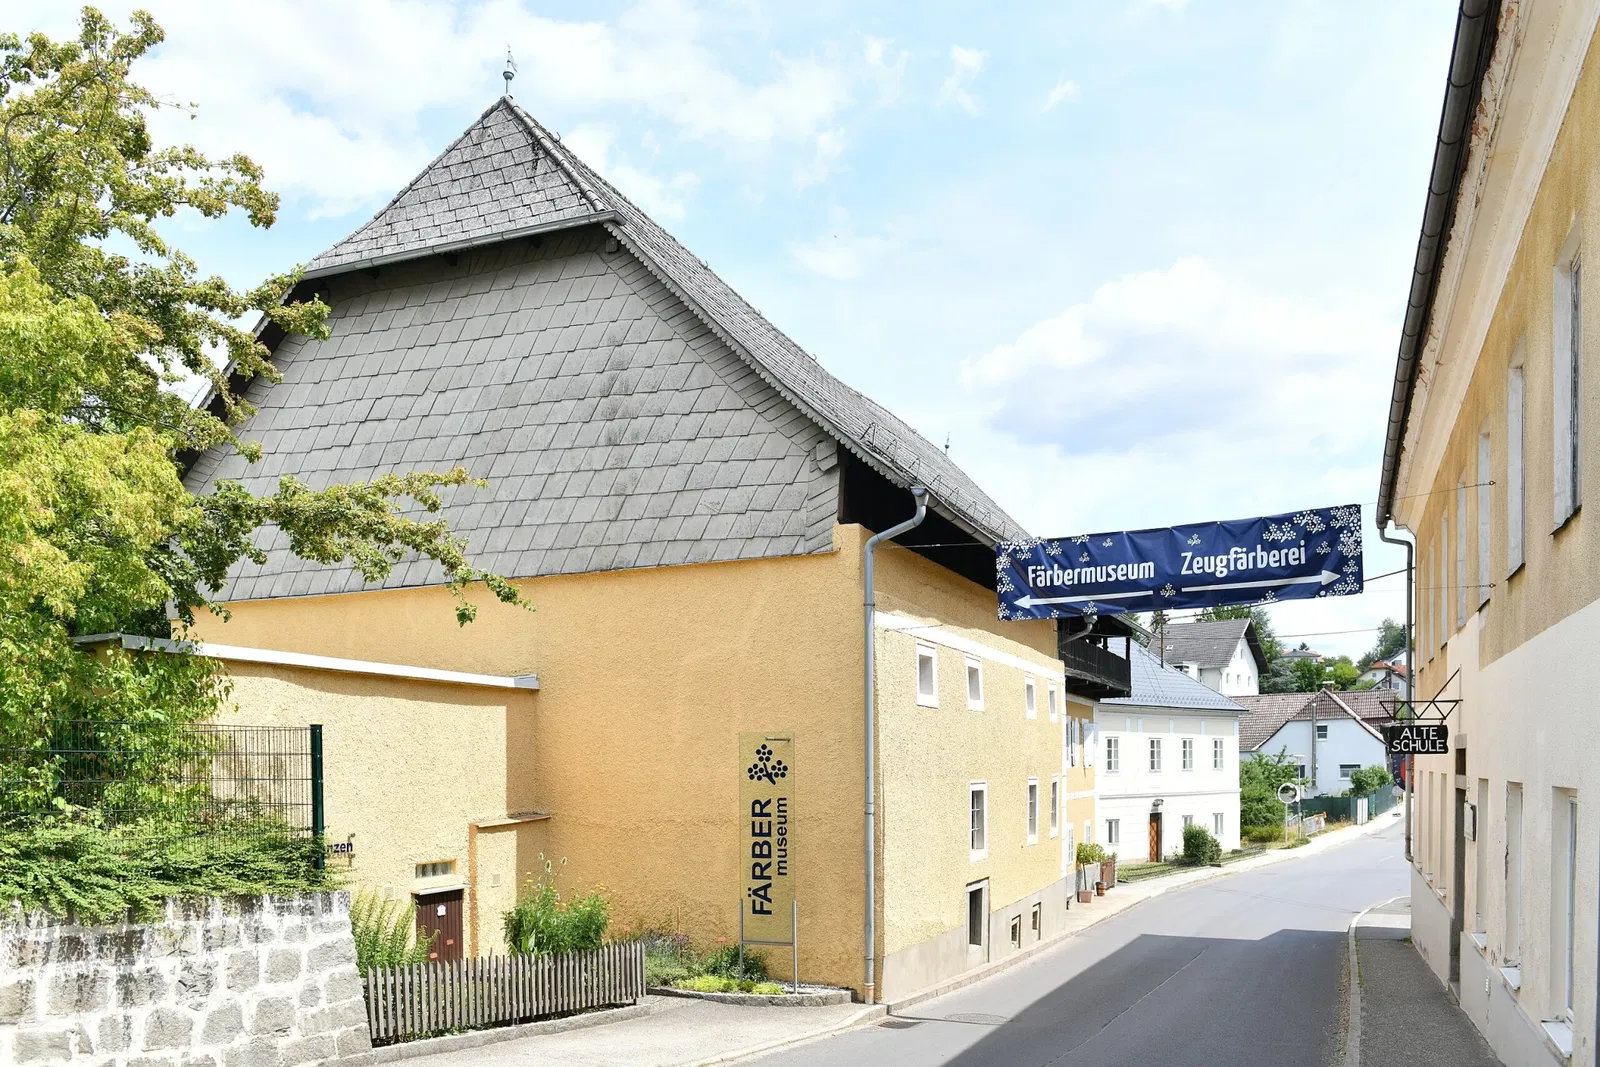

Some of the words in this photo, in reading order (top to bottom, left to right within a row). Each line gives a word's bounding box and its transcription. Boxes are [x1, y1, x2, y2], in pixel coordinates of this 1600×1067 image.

[1027, 559, 1155, 588] Färbermuseum
[1180, 540, 1306, 578] Zeugfärberei
[1391, 739, 1445, 752] SCHULE
[1400, 727, 1438, 740] ALTE
[326, 842, 353, 853] nzen
[776, 797, 788, 876] museum
[747, 798, 773, 915] FÄRBER
